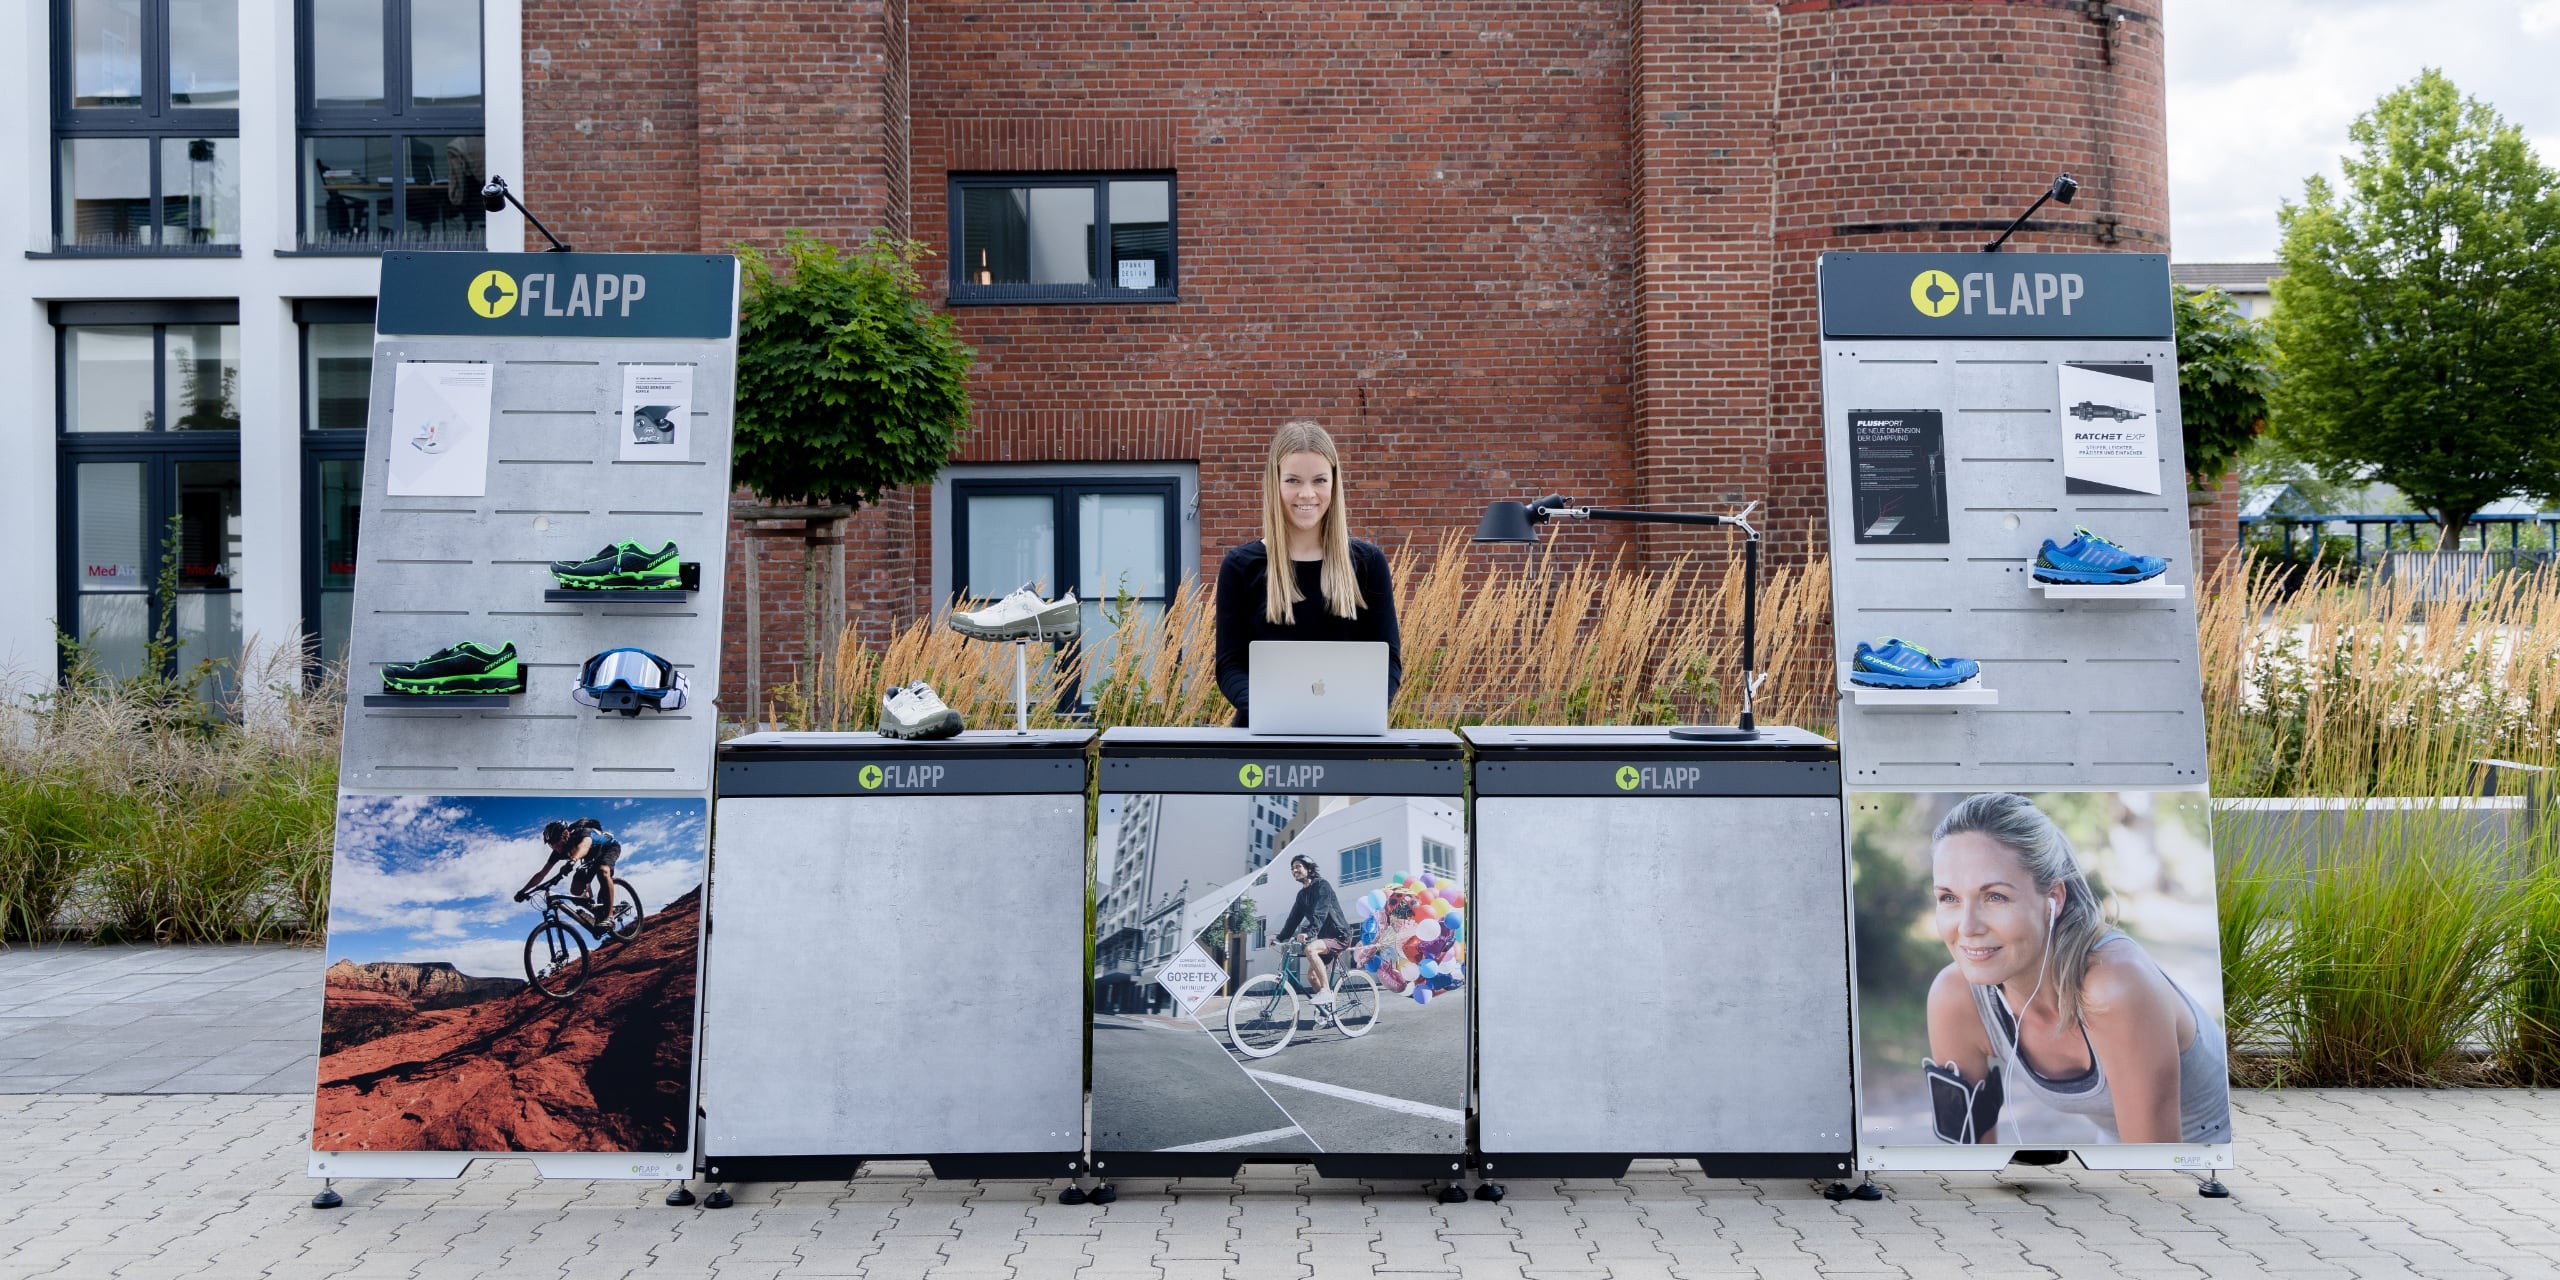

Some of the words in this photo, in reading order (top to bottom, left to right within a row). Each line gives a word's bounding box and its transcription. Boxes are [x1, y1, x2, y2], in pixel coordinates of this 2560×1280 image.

[520, 273, 646, 317] FLAPP
[1962, 272, 2084, 316] FLAPP
[2126, 433, 2146, 441] EXP
[88, 563, 137, 577] MedAix
[884, 765, 945, 788] FLAPP
[1264, 765, 1325, 788] FLAPP
[1640, 767, 1700, 790] FLAPP
[638, 1165, 660, 1173] FLAPP
